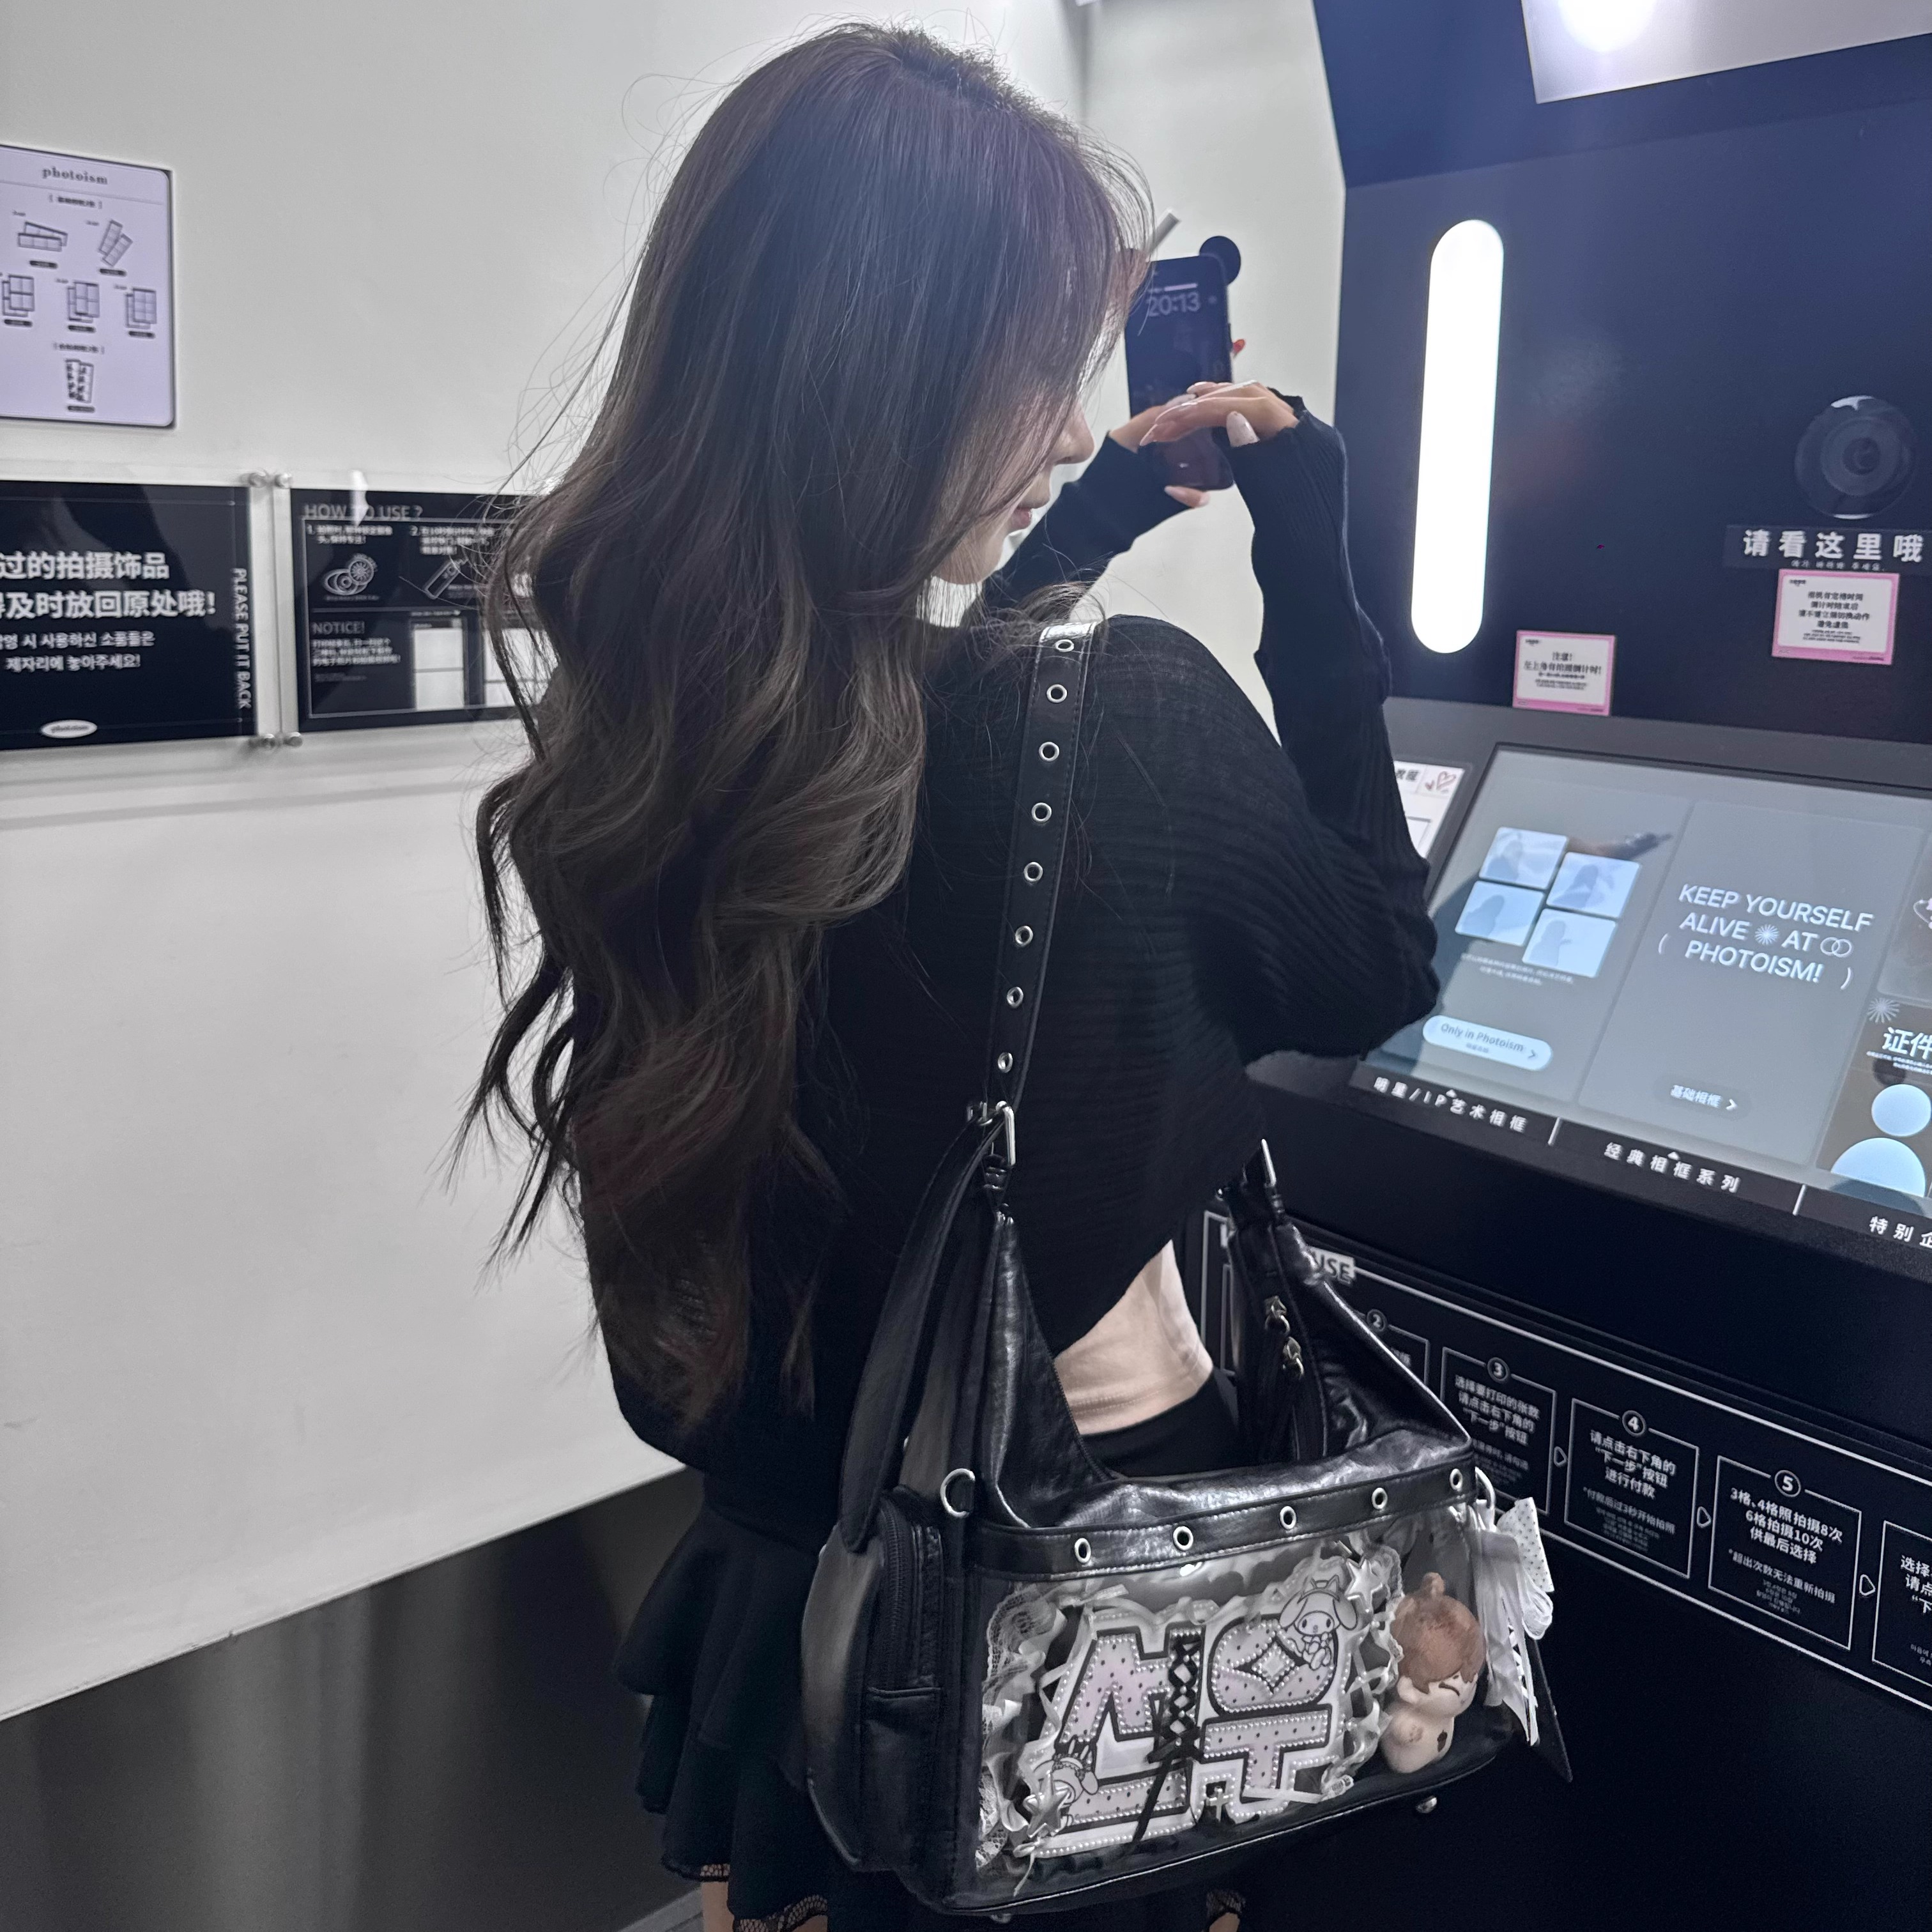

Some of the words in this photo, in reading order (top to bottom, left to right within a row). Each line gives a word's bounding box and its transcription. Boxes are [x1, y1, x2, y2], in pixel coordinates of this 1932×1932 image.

[42, 166, 108, 185] photoism
[1148, 291, 1201, 317] 20:13
[305, 503, 346, 519] HOW
[378, 505, 410, 520] USE
[1743, 529, 1924, 563] 请看这里哦
[0, 551, 170, 579] 过的拍摄饰品
[232, 568, 249, 622] PLEASE
[234, 624, 249, 652] PUT
[312, 621, 365, 634] NOTICE!
[234, 654, 250, 668] IT
[234, 670, 252, 709] BACK
[1678, 884, 1739, 909] KEEP
[1745, 893, 1874, 933] YOURSELF
[1679, 912, 1751, 940] ALIVE
[1781, 929, 1819, 952] AT
[1684, 939, 1824, 983] PHOTOISM!
[1440, 1022, 1464, 1040] Only
[1465, 1027, 1475, 1039] in
[1476, 1031, 1525, 1053] Photoism
[1882, 1026, 1932, 1061] 证件
[1603, 1142, 1742, 1193] 经典相框系列
[1372, 1314, 1381, 1328] 2
[1494, 1362, 1504, 1377] 3
[1627, 1416, 1639, 1431] 4
[1590, 1429, 1677, 1477] 请点击右下角的
[1604, 1466, 1656, 1500] 进行付款
[1782, 1475, 1793, 1492] 5
[1745, 1510, 1824, 1552] 6格拍摄10次
[1749, 1526, 1817, 1565] 供最后选择
[1901, 1554, 1932, 1579] 选择
